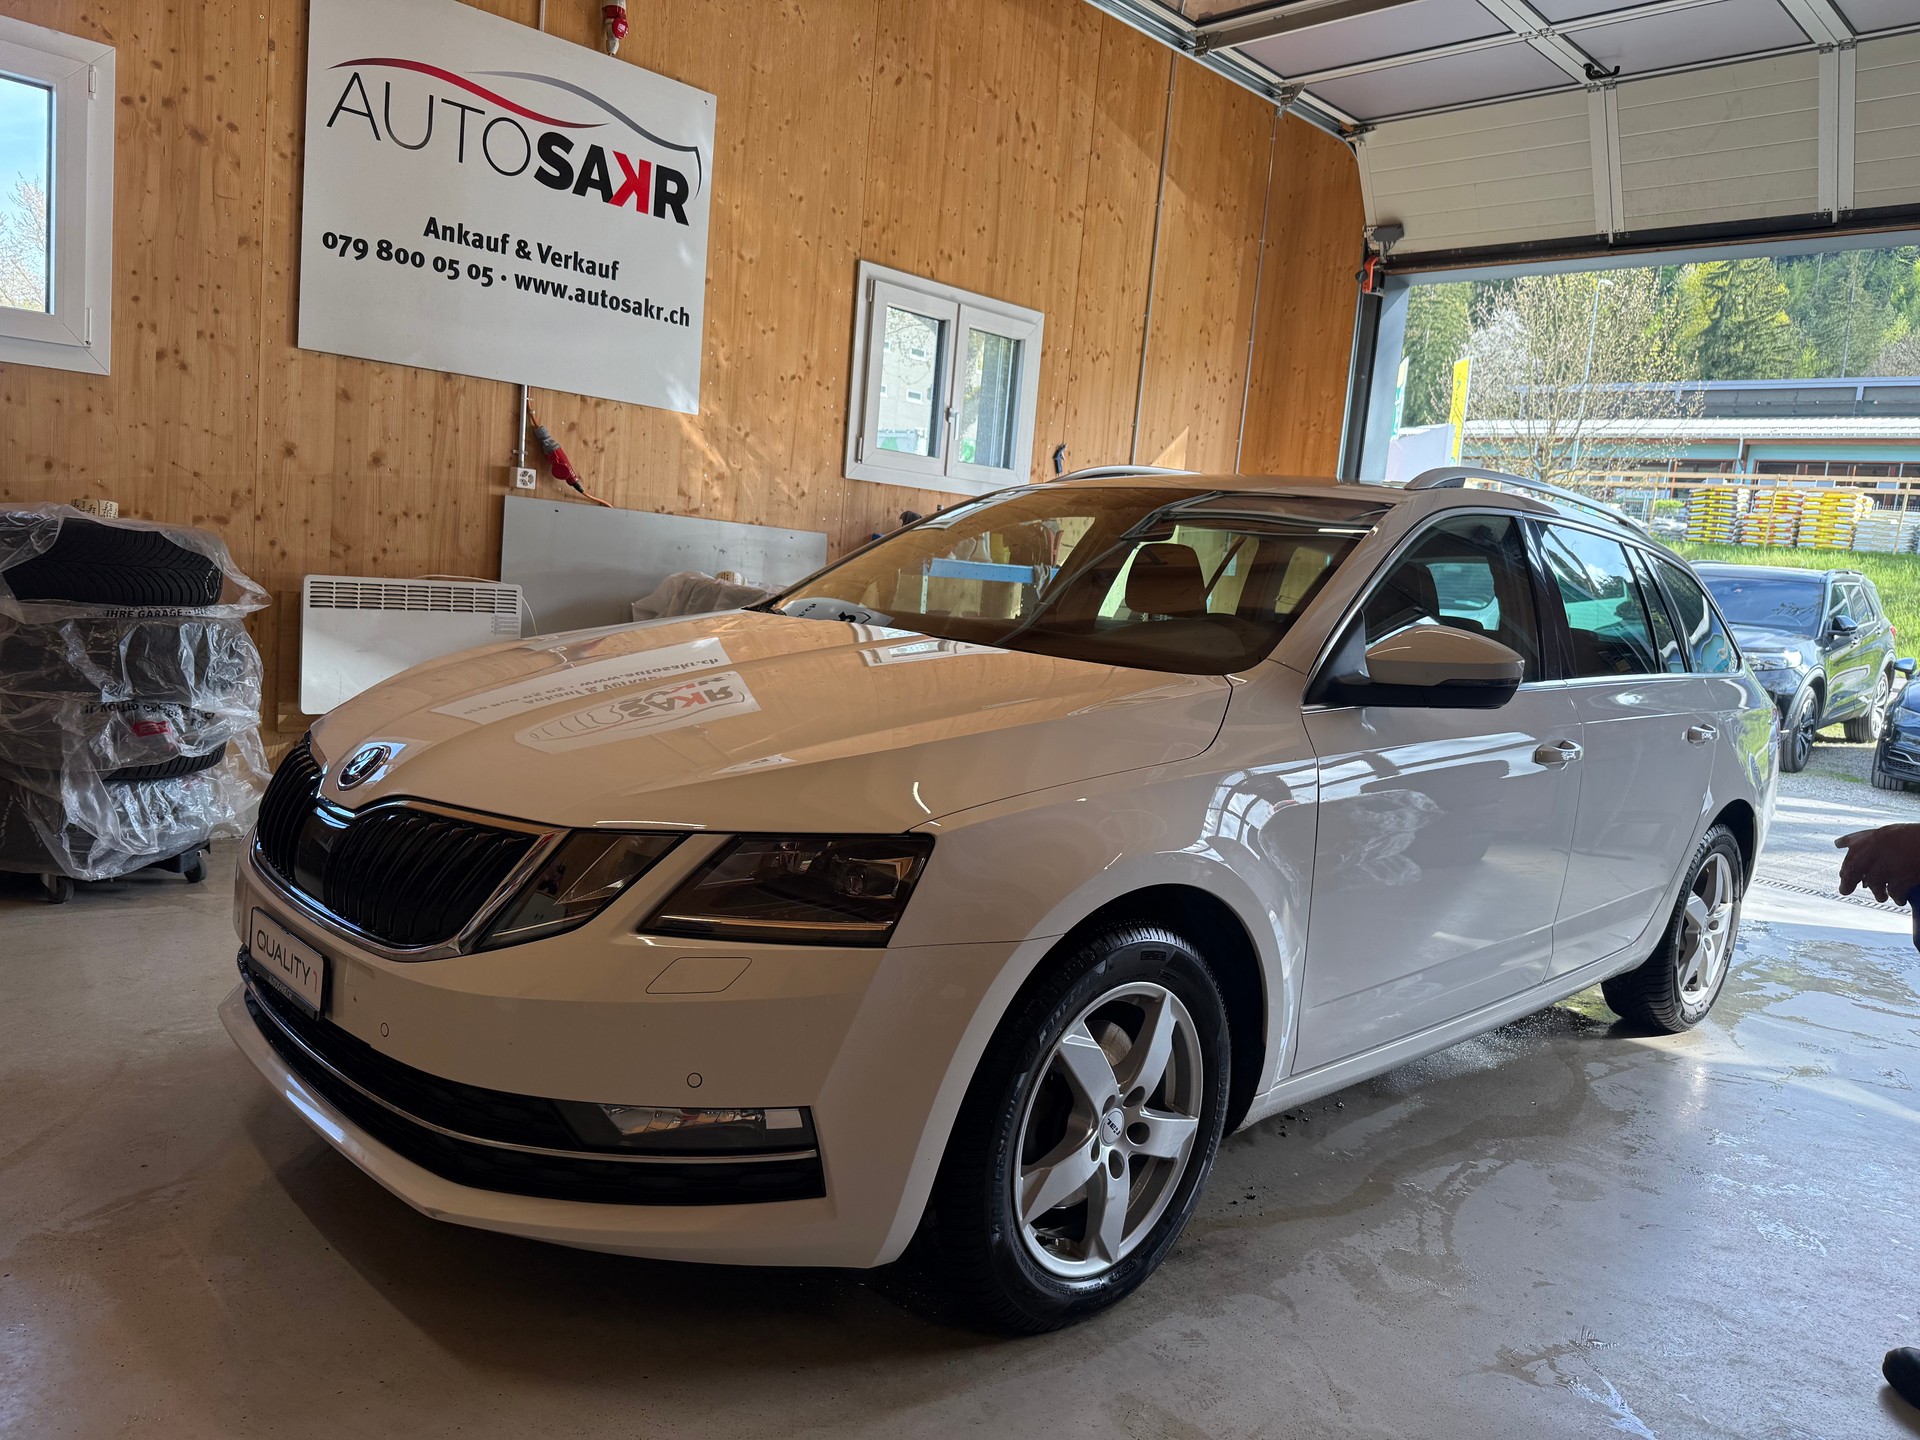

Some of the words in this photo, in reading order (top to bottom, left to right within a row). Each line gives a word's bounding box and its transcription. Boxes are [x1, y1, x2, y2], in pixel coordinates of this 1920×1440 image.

[326, 72, 690, 226] AUTOSAKR
[322, 231, 369, 260] 079
[376, 239, 425, 268] 800
[433, 257, 460, 280] 05
[467, 265, 494, 287] 05
[514, 272, 691, 327] www.autosakr.ch
[423, 216, 510, 255] Ankauf
[516, 239, 532, 261] &
[537, 242, 620, 282] Verkauf
[138, 608, 183, 618] GARAGE
